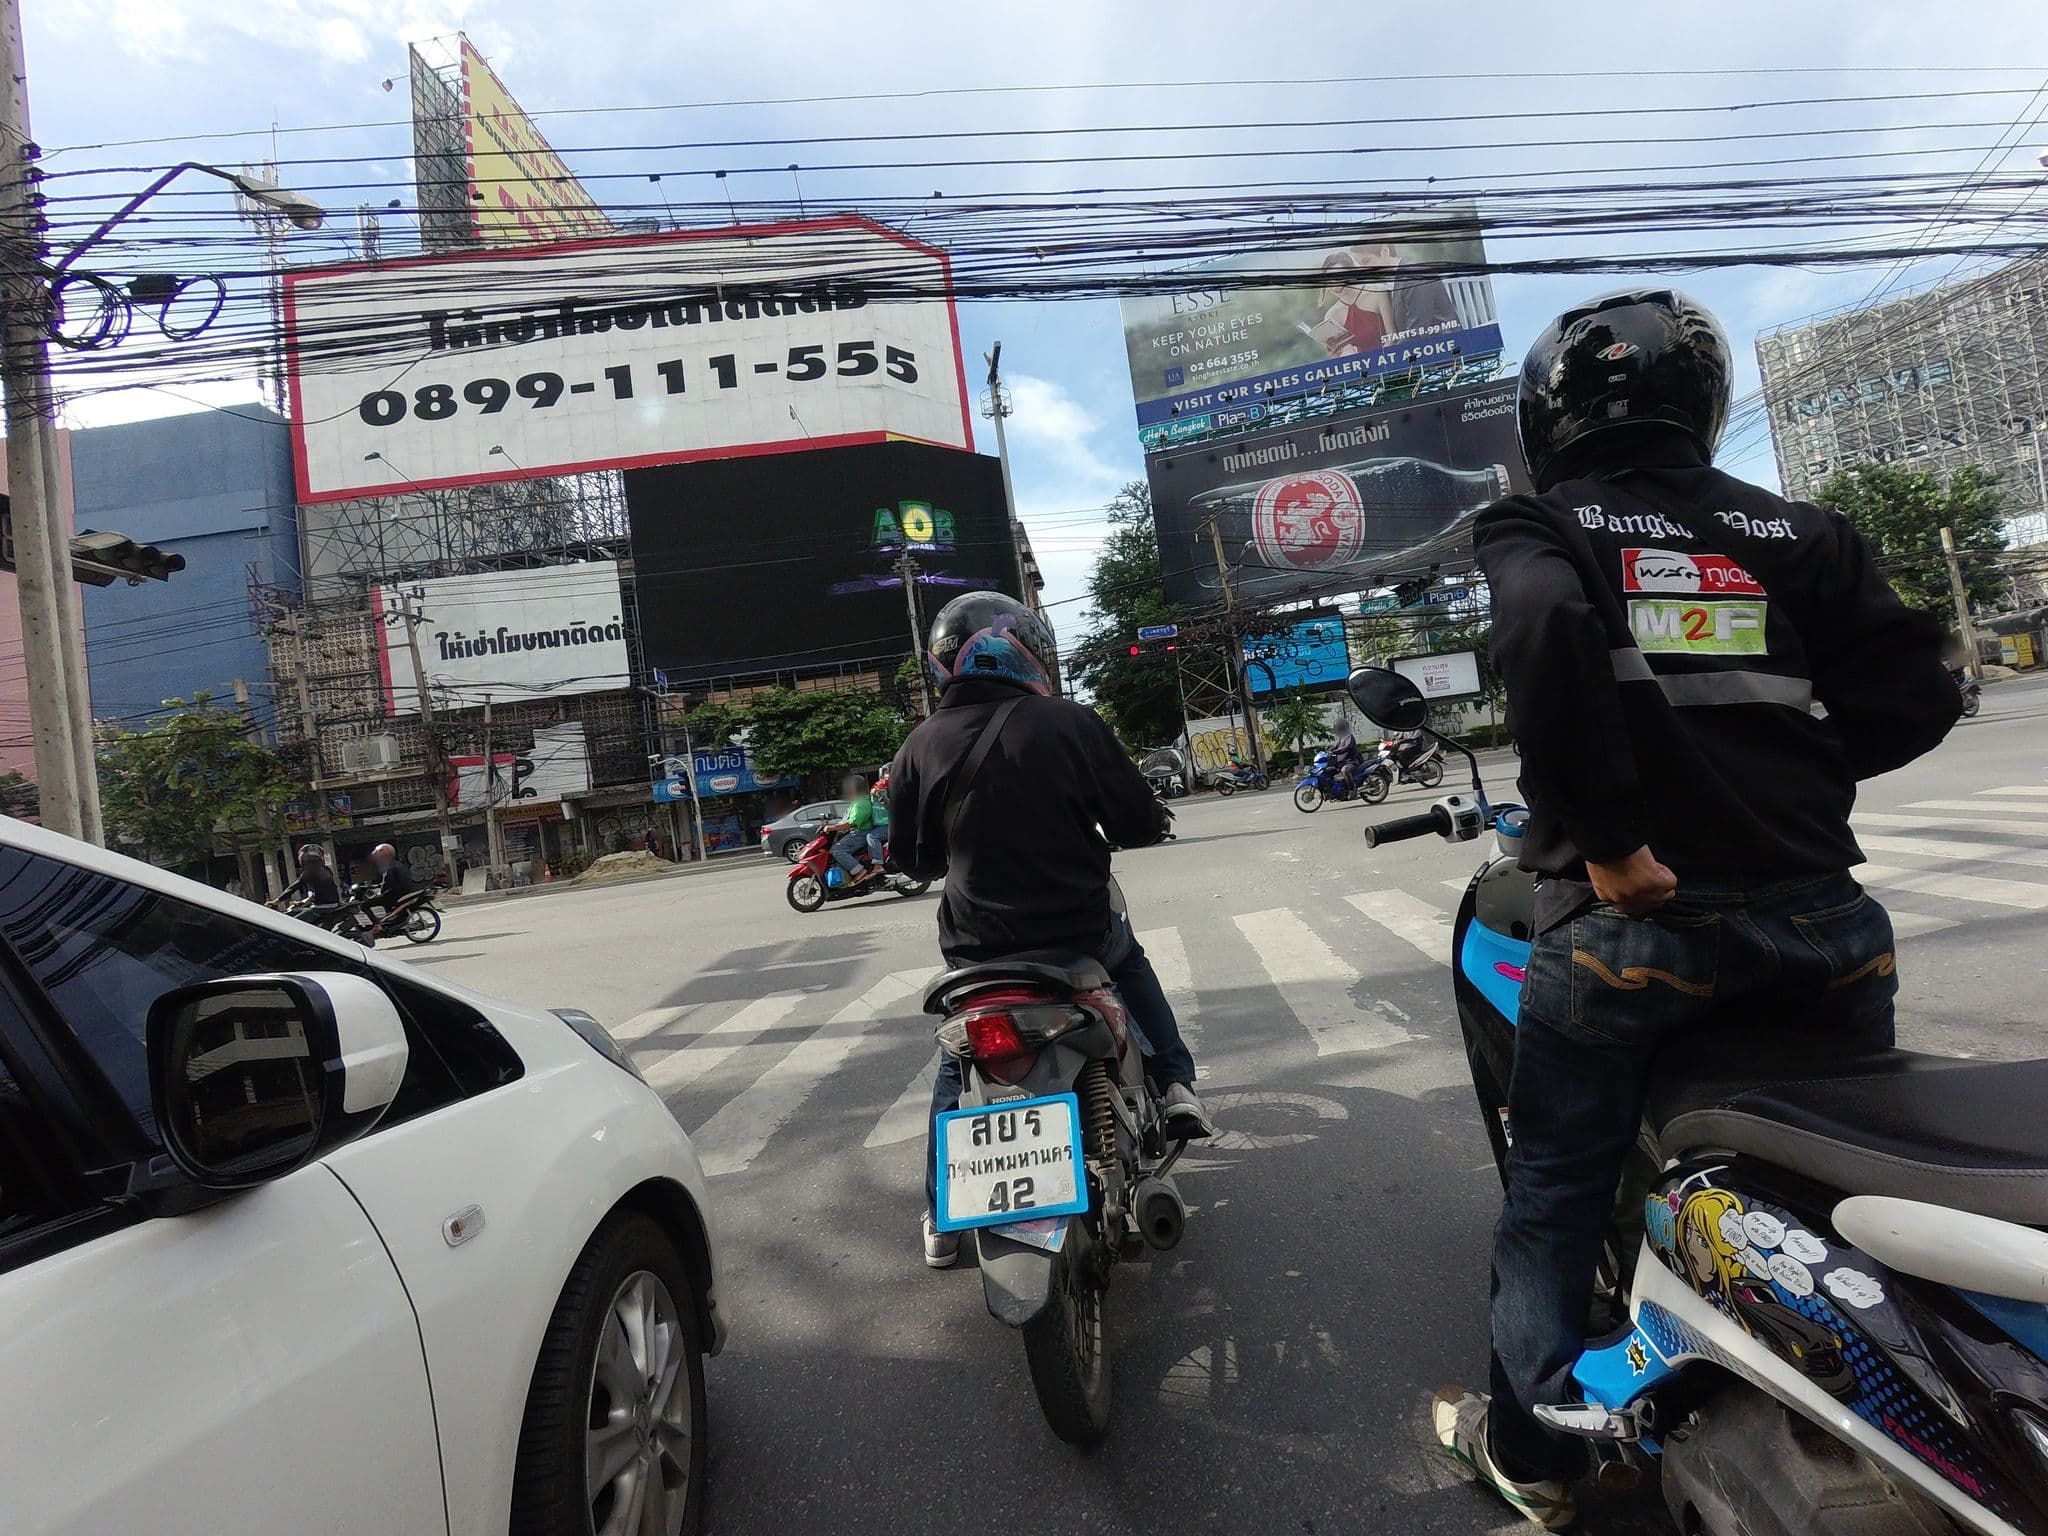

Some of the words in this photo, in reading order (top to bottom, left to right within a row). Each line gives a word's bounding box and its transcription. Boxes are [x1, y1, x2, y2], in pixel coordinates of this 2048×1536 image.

[1171, 288, 1231, 315] ESSE
[1152, 331, 1185, 348] KEEP
[1189, 322, 1226, 339] YOUR
[1230, 313, 1263, 330] EYES
[1170, 343, 1190, 357] ON
[1195, 329, 1249, 352] NATURE
[1380, 328, 1416, 344] STARTS
[1418, 324, 1440, 336] 8.99
[1441, 319, 1461, 331] MB.
[1174, 394, 1213, 412] VISIT
[1217, 386, 1249, 402] OUR
[1254, 375, 1300, 394] SALES
[1304, 356, 1371, 382] GALLERY
[1377, 352, 1397, 366] AT
[1402, 339, 1457, 360] ASOKE
[1190, 361, 1205, 373] 02
[1206, 355, 1229, 369] 664
[1230, 350, 1259, 365] 3555
[358, 341, 919, 427] 0899-111-555
[1170, 418, 1206, 436] Bangkok
[1315, 474, 1344, 499] SODA
[1573, 504, 1695, 540] Bangk
[1713, 511, 1798, 541] Post
[1429, 591, 1454, 604] Plan
[1635, 607, 1760, 641] M2F
[991, 1093, 1027, 1104] HONDA
[947, 1145, 1072, 1183] กุงเทพมหานคร
[988, 1176, 1036, 1212] 42
